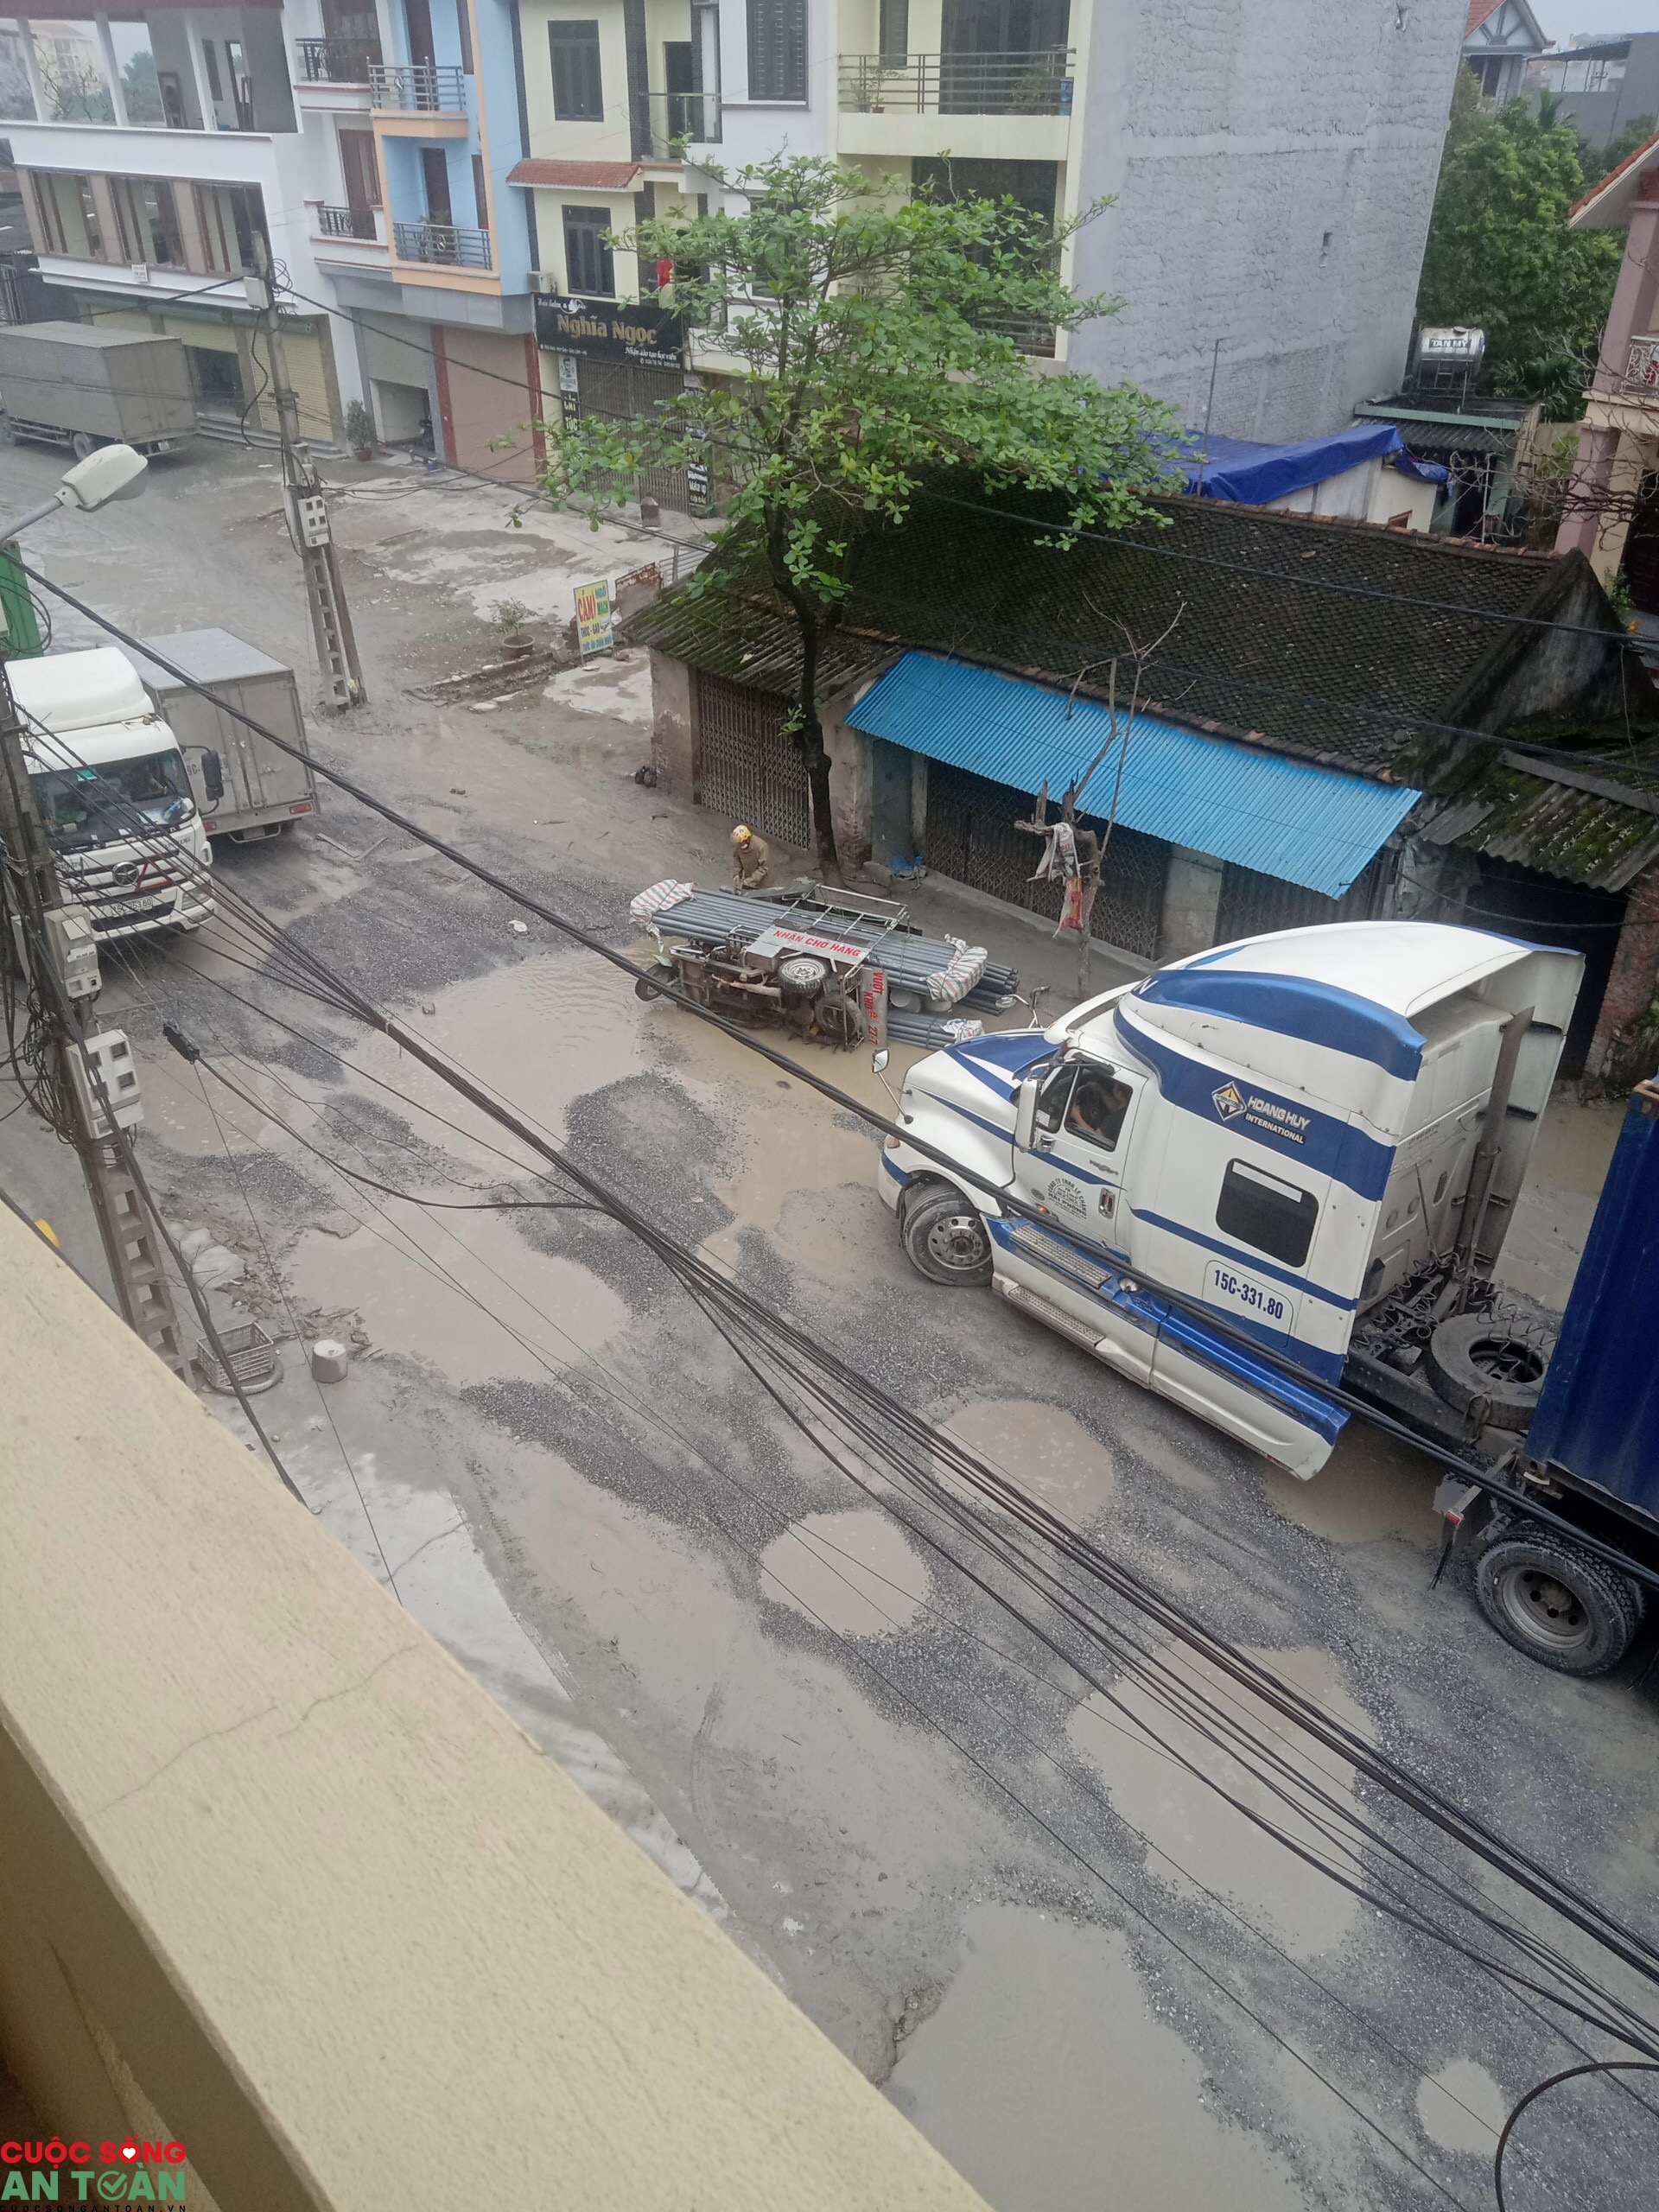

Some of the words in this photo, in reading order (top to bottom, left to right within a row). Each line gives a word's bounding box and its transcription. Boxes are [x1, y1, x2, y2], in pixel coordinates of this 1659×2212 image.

[556, 314, 608, 339] Nghĩa
[611, 320, 658, 347] Ngọc
[1244, 1112, 1305, 1145] INTERNATIONAL
[1214, 1268, 1284, 1320] 15C-331.80
